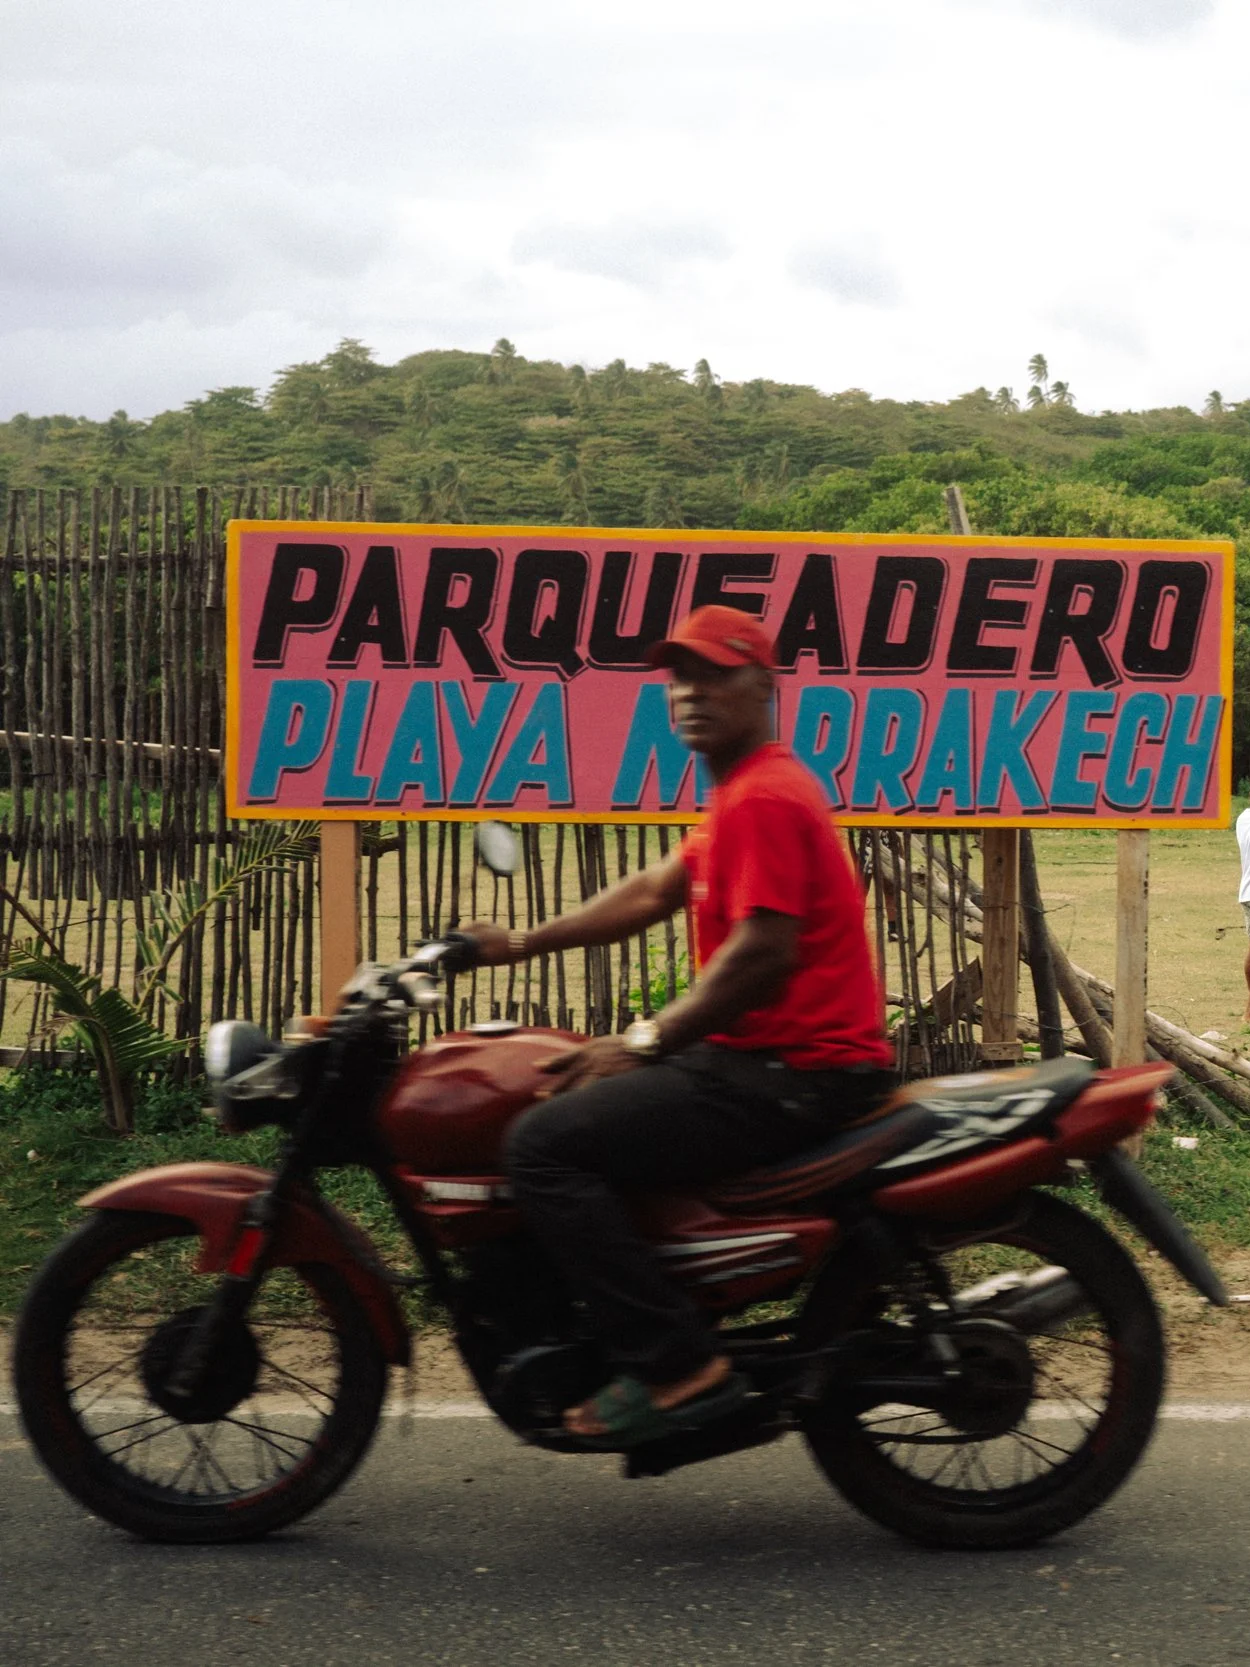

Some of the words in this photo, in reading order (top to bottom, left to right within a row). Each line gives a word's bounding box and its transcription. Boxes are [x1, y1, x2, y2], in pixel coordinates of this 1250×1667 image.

[252, 543, 1213, 690] PARQUEADERO
[246, 679, 575, 808] PLAYA
[611, 683, 1227, 814] MRRAKECH
